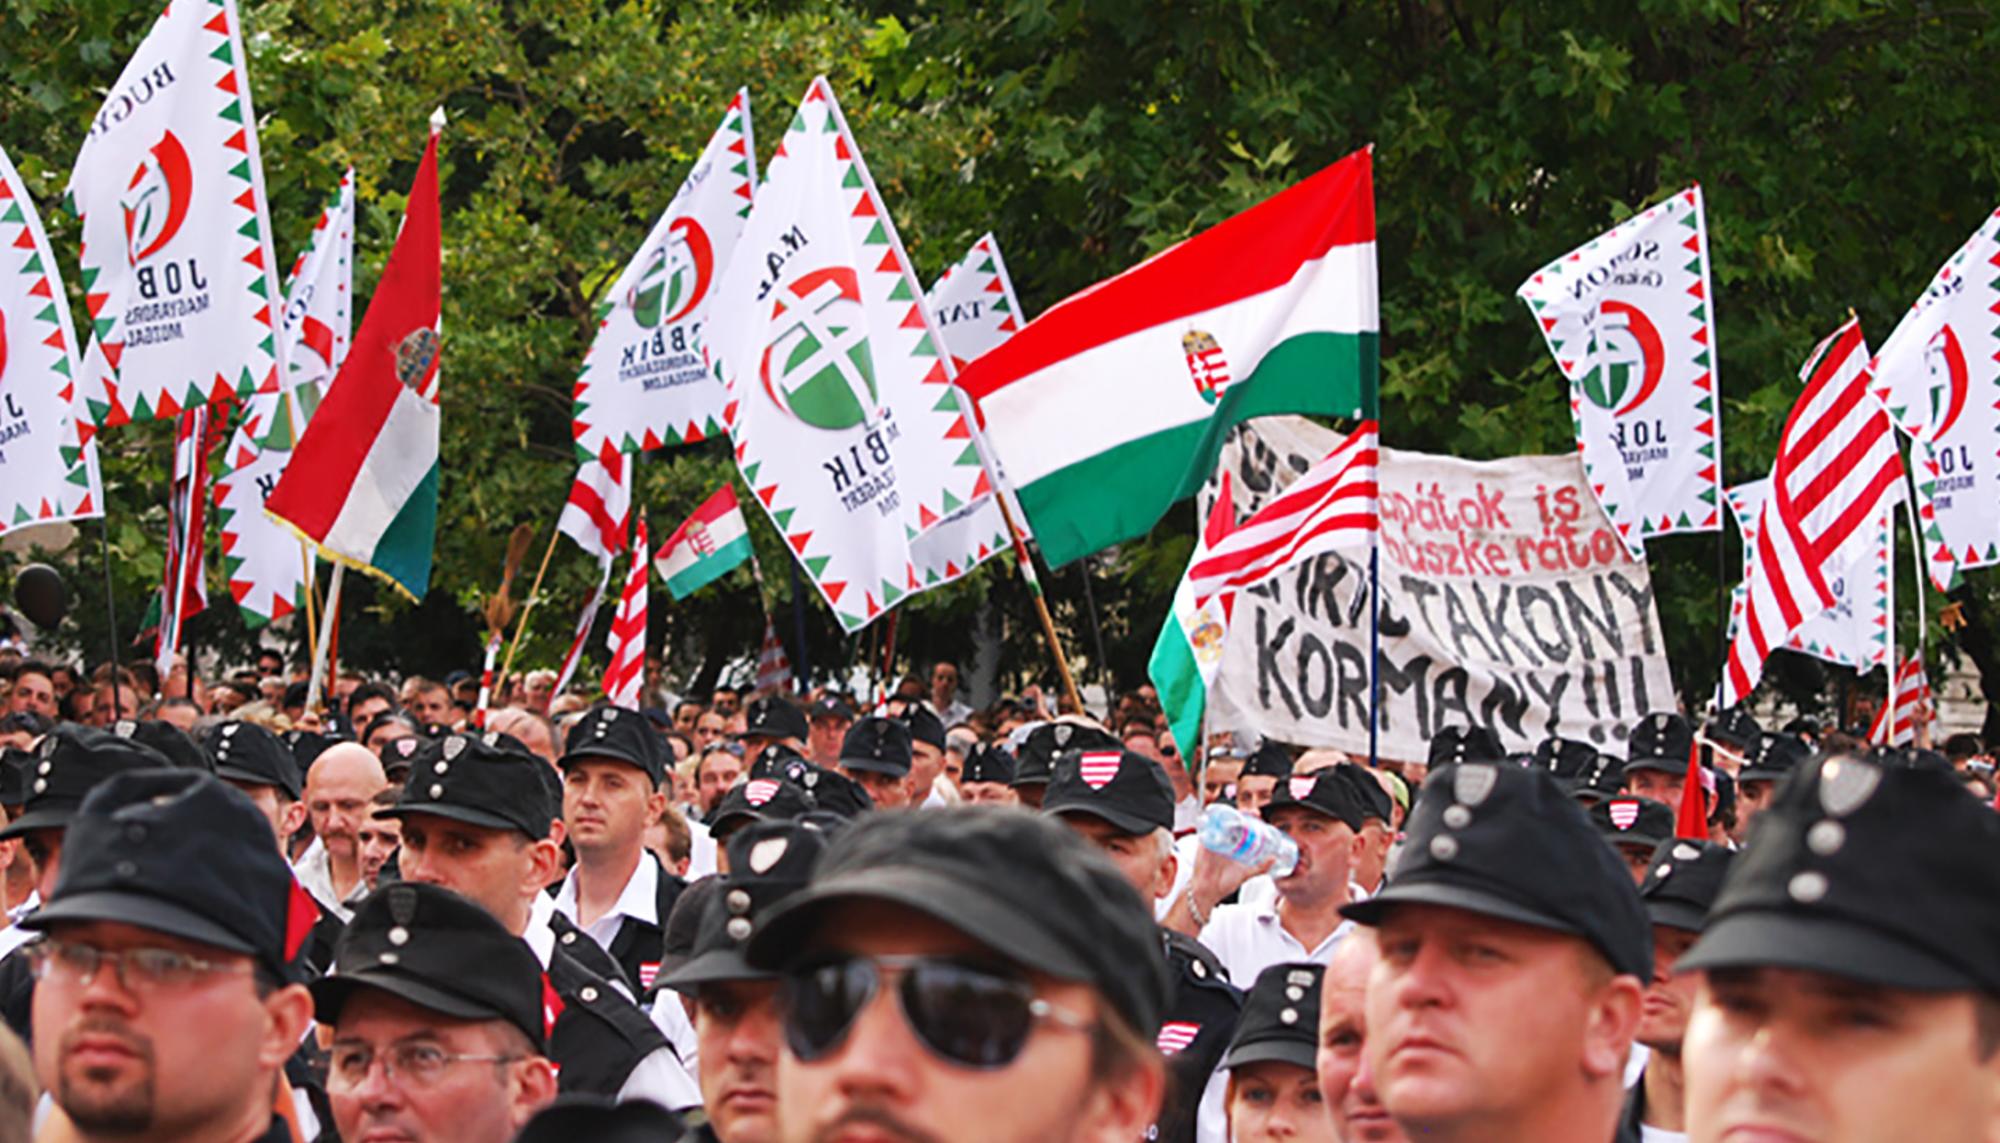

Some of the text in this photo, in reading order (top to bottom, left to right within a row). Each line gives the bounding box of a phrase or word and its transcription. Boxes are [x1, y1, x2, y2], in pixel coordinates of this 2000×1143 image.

[1535, 484, 1582, 524] is
[1515, 524, 1633, 573] ráto
[1399, 570, 1655, 667] TAKONY
